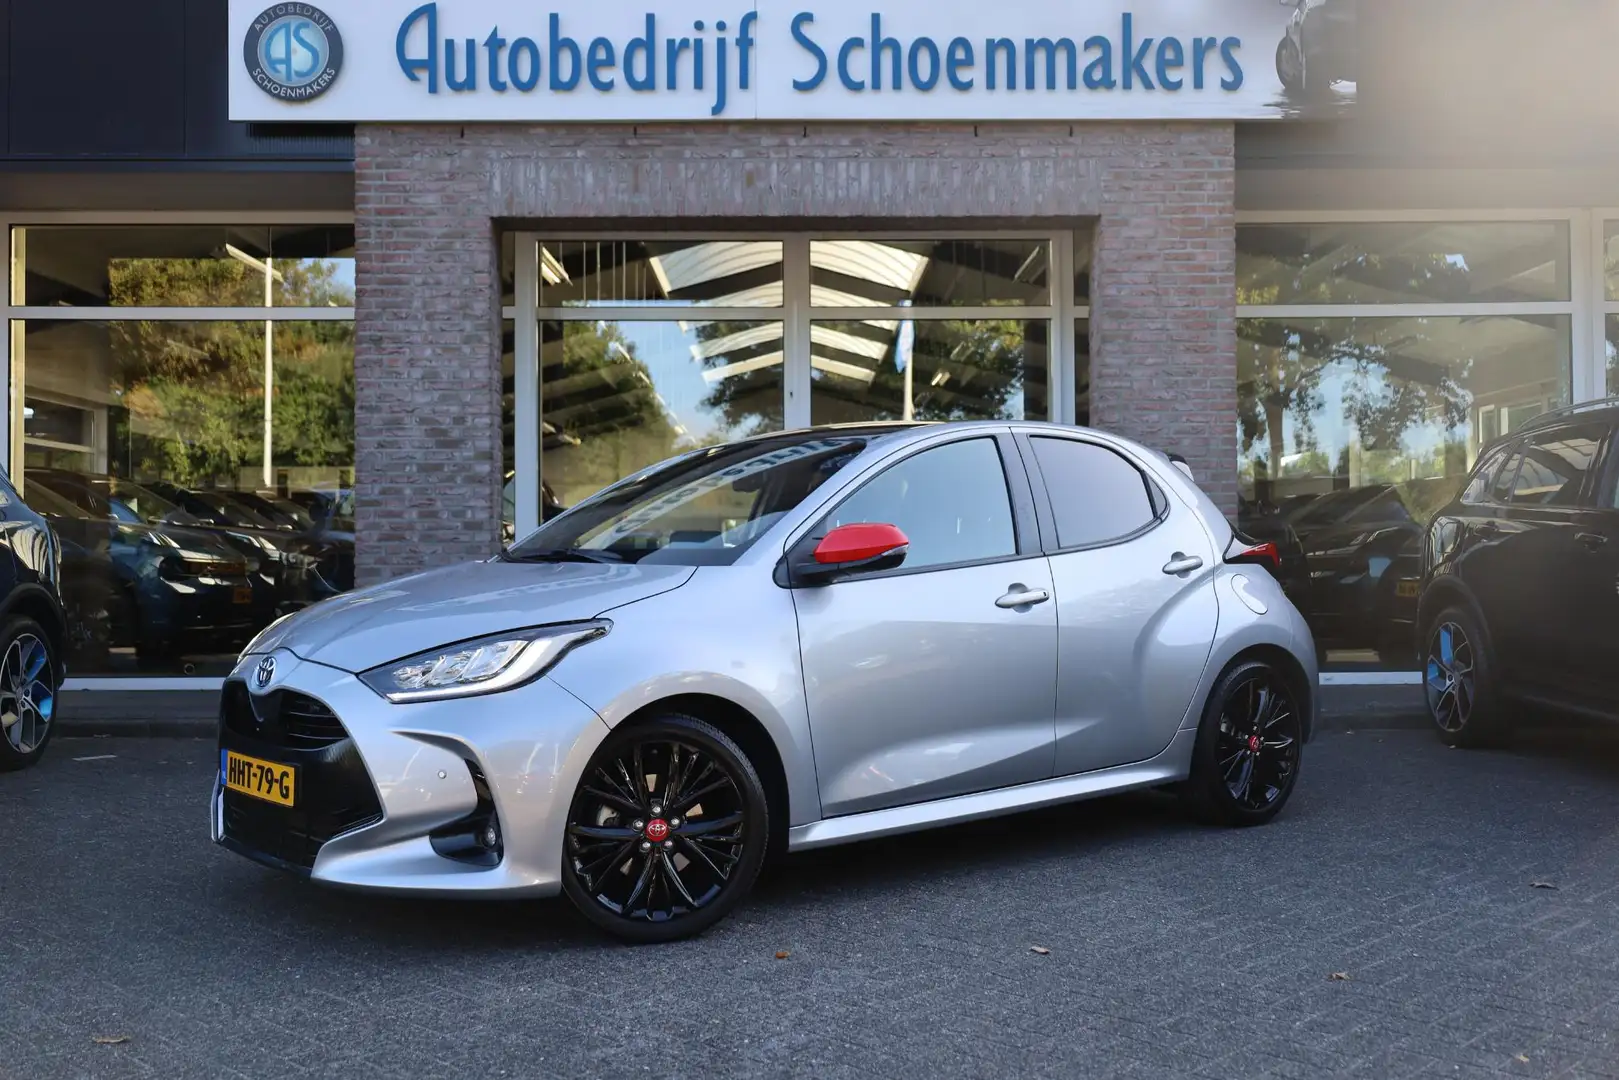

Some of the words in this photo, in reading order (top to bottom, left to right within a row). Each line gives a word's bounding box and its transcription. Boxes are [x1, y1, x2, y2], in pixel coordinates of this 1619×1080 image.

[254, 4, 335, 32] AUTOBEDRIJF
[265, 21, 320, 82] AS
[396, 2, 758, 116] Autobedrijf
[790, 12, 1244, 92] Schoenmakers
[252, 67, 336, 98] SCHOENMAKERS
[228, 757, 290, 799] HHT-79-G
